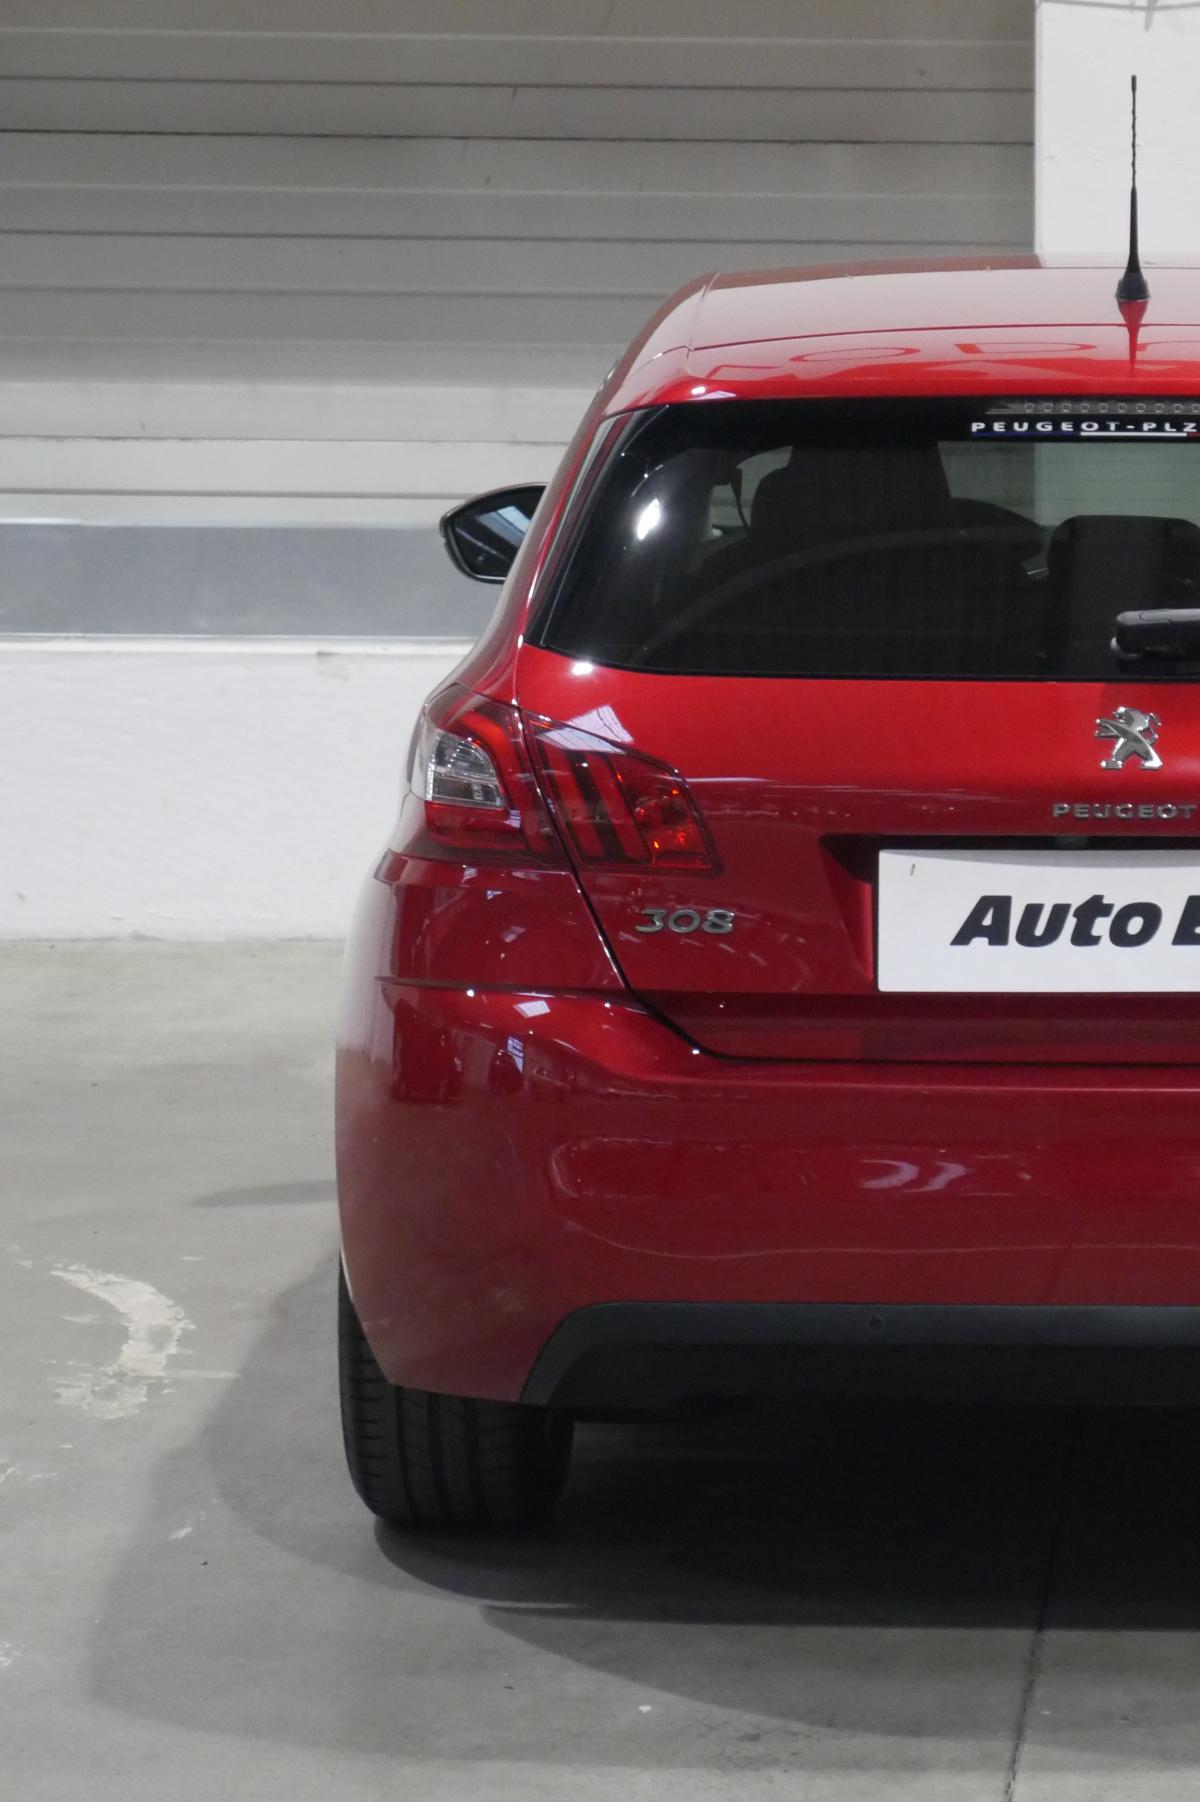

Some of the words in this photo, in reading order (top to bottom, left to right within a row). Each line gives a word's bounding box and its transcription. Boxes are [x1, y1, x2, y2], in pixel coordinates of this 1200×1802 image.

[1052, 803, 1198, 819] PEUGEOT
[634, 909, 736, 934] 308
[949, 894, 1163, 948] Auto
